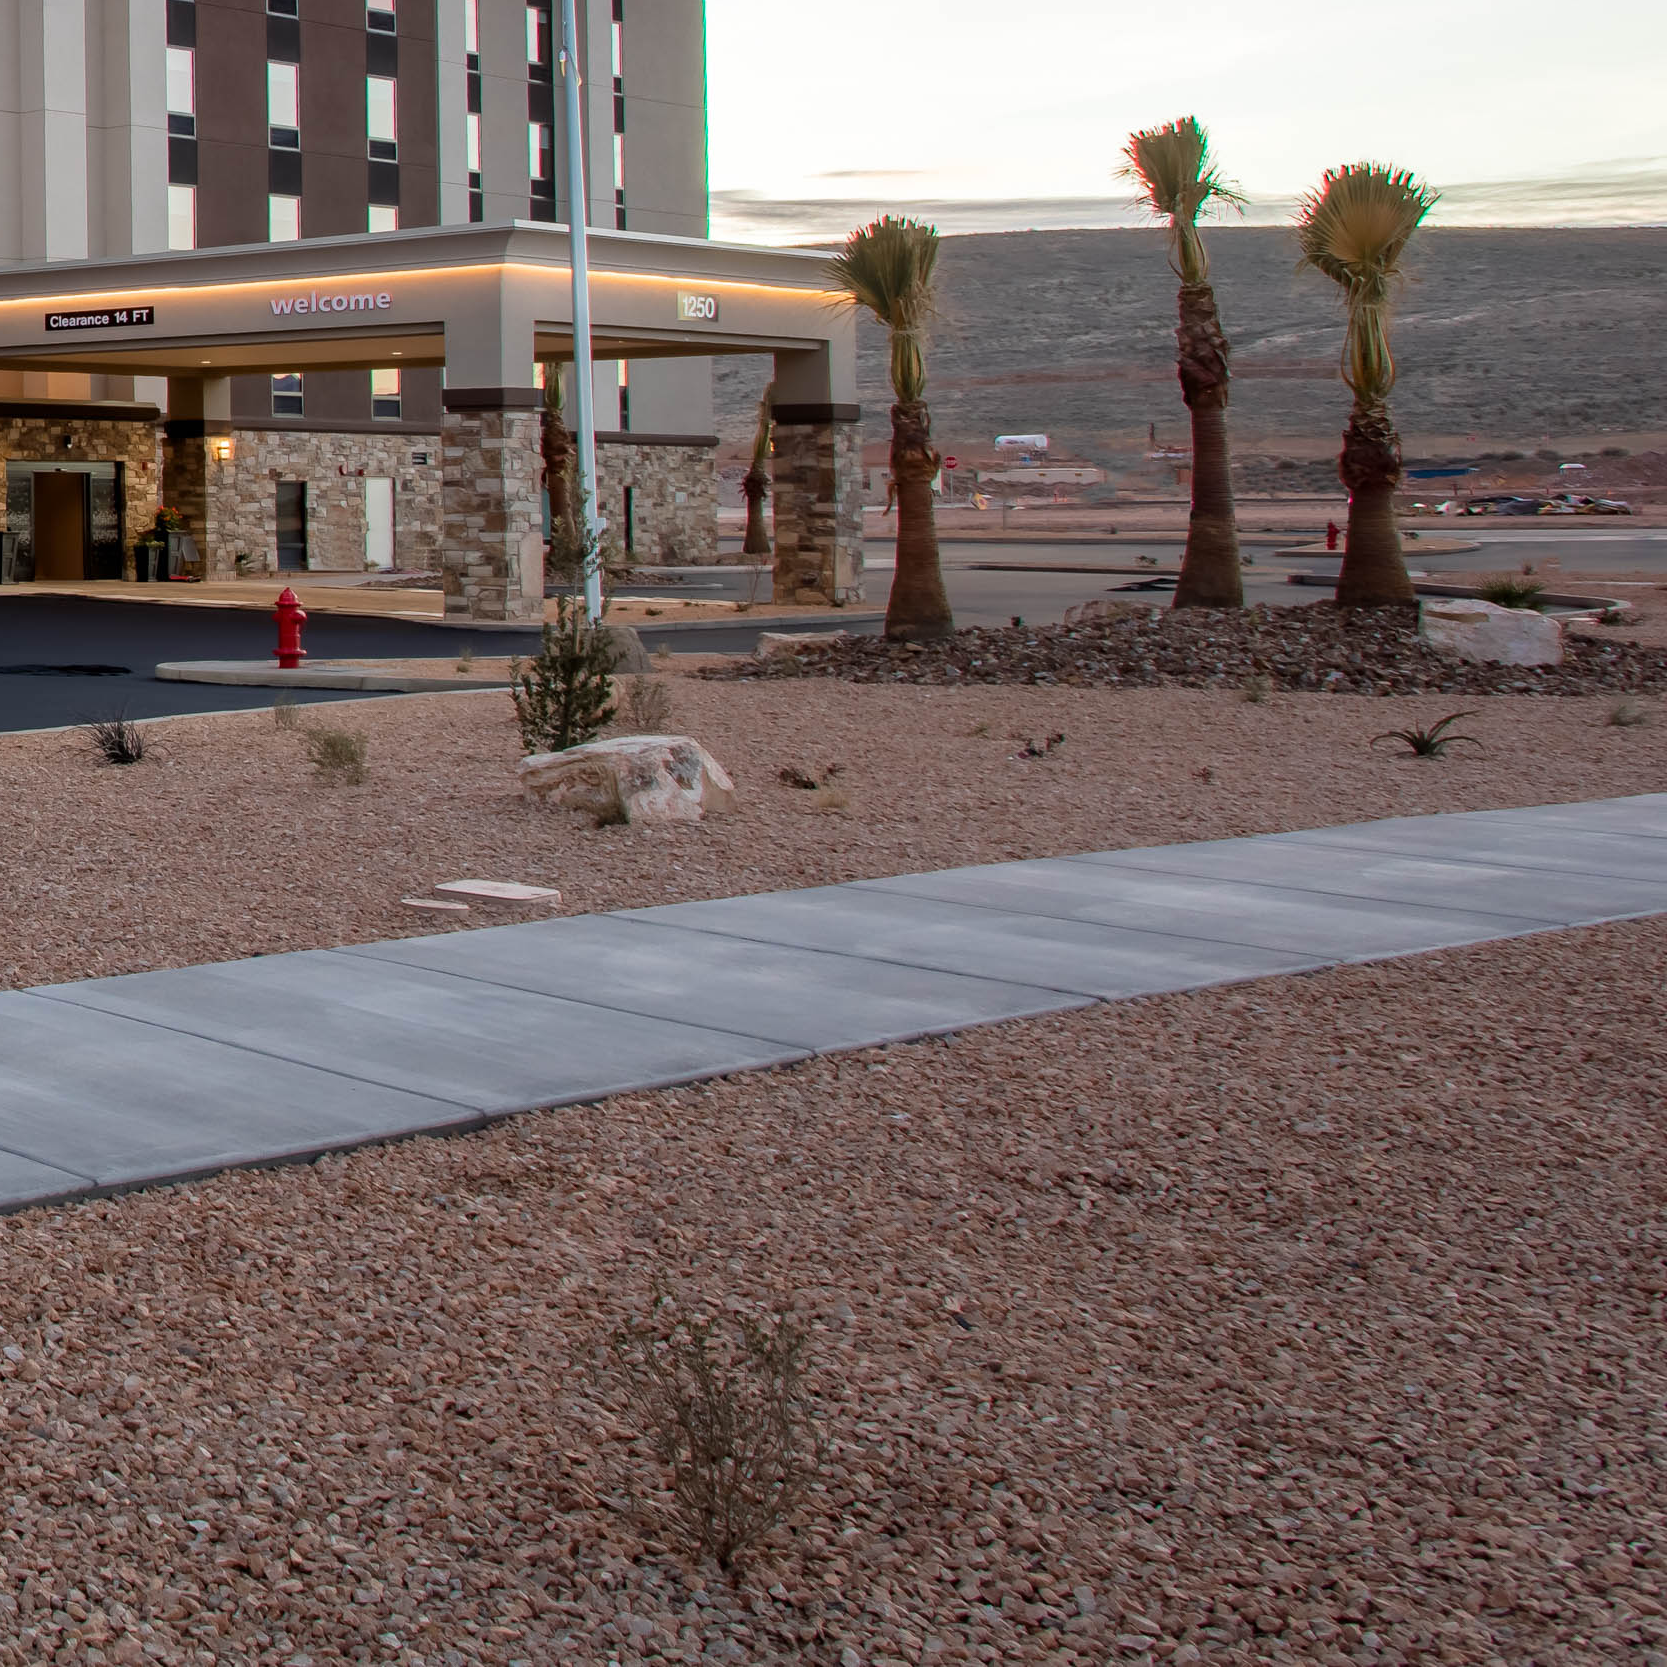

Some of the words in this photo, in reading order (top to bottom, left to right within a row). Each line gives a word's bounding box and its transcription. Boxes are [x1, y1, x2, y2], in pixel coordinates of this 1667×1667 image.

[270, 290, 391, 315] welcome
[682, 295, 714, 319] 1250
[50, 315, 109, 328] Clearance
[114, 311, 127, 323] 14
[132, 309, 149, 322] FT
